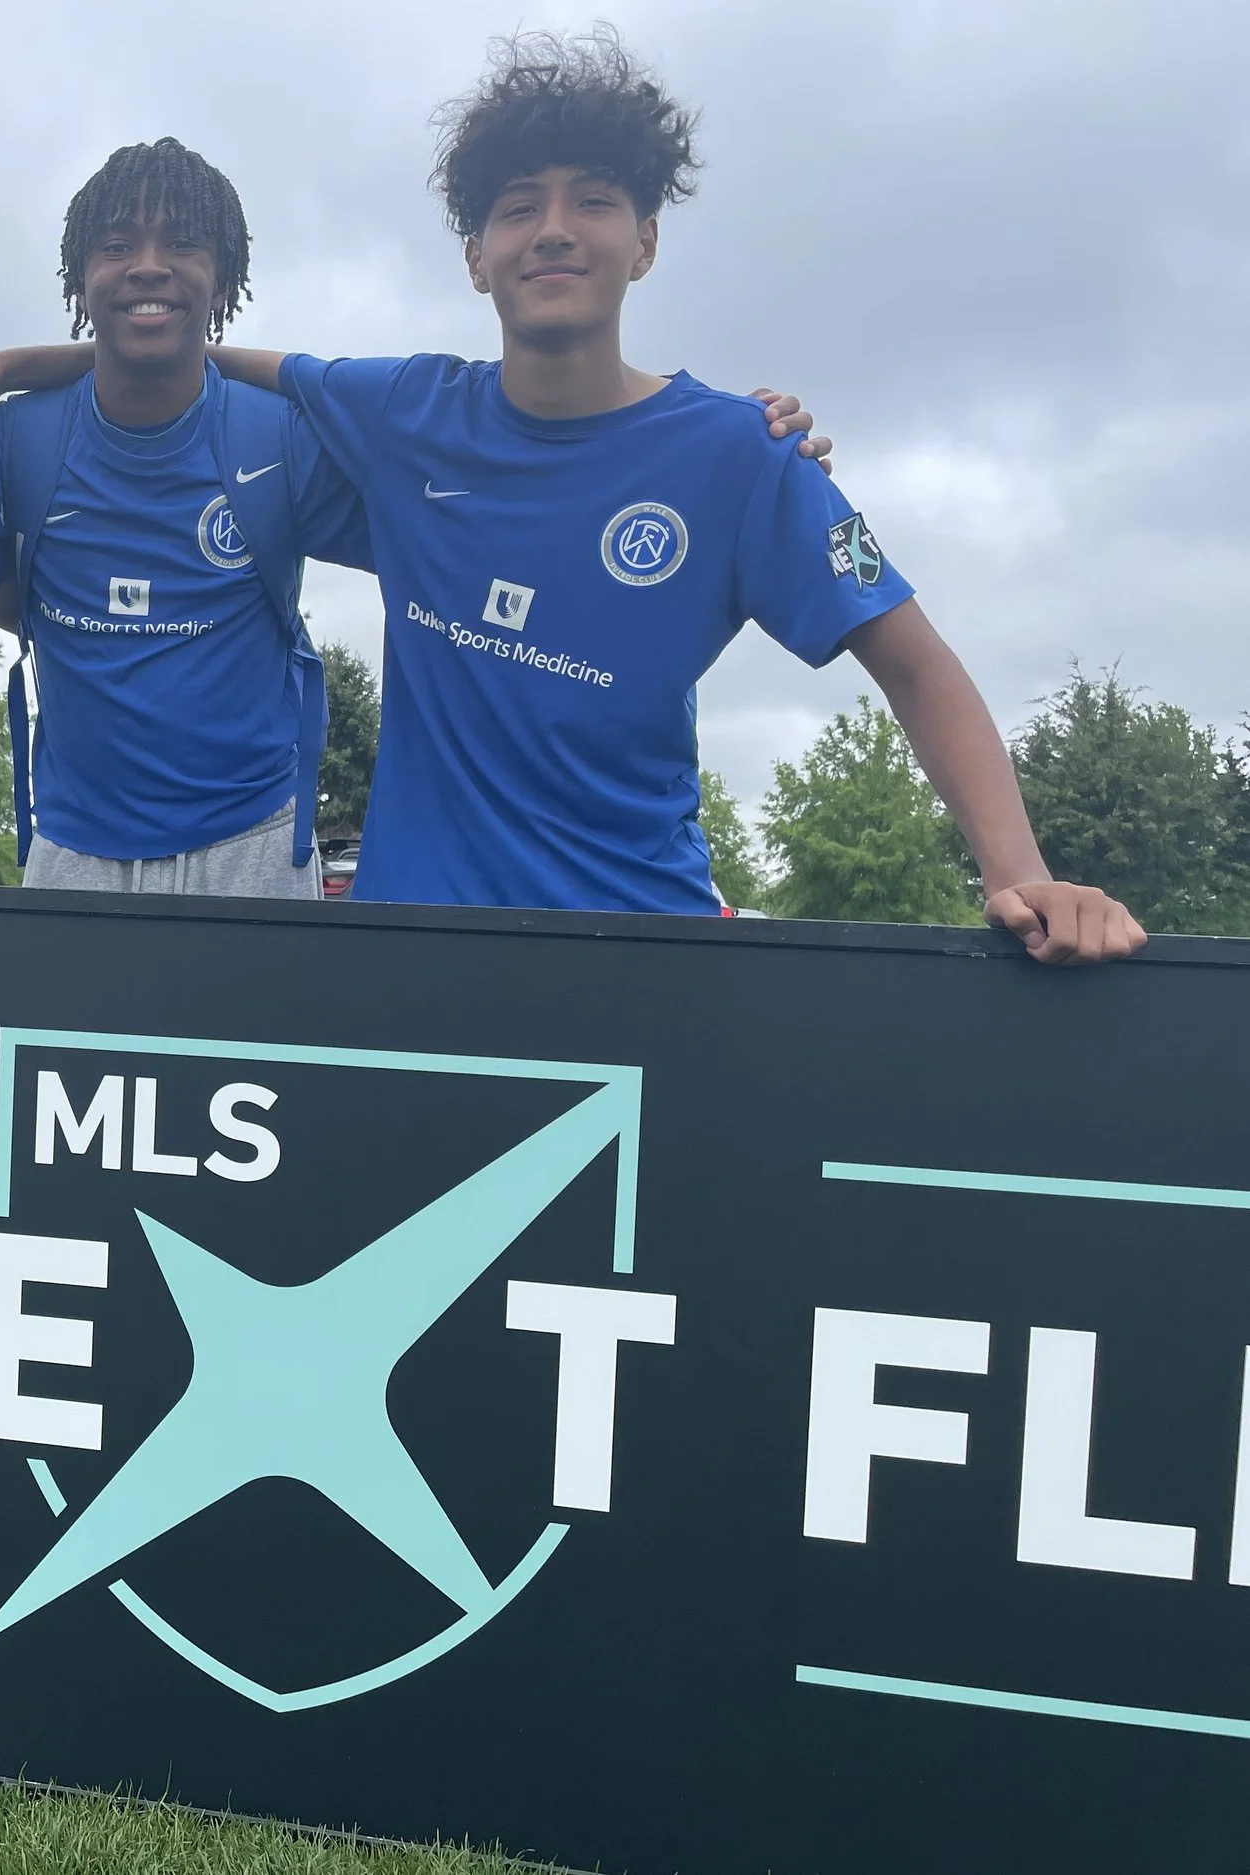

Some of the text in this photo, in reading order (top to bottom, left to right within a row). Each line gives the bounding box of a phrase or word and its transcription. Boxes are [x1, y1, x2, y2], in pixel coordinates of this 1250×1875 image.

[643, 506, 667, 516] WAKE
[208, 551, 233, 566] FUTBOL
[609, 562, 661, 583] FUTBOL CLUB
[79, 616, 141, 633] Sports
[407, 601, 614, 688] Duke Sports Medicine
[34, 1069, 282, 1183] MLS
[802, 1306, 1250, 1588] FL
